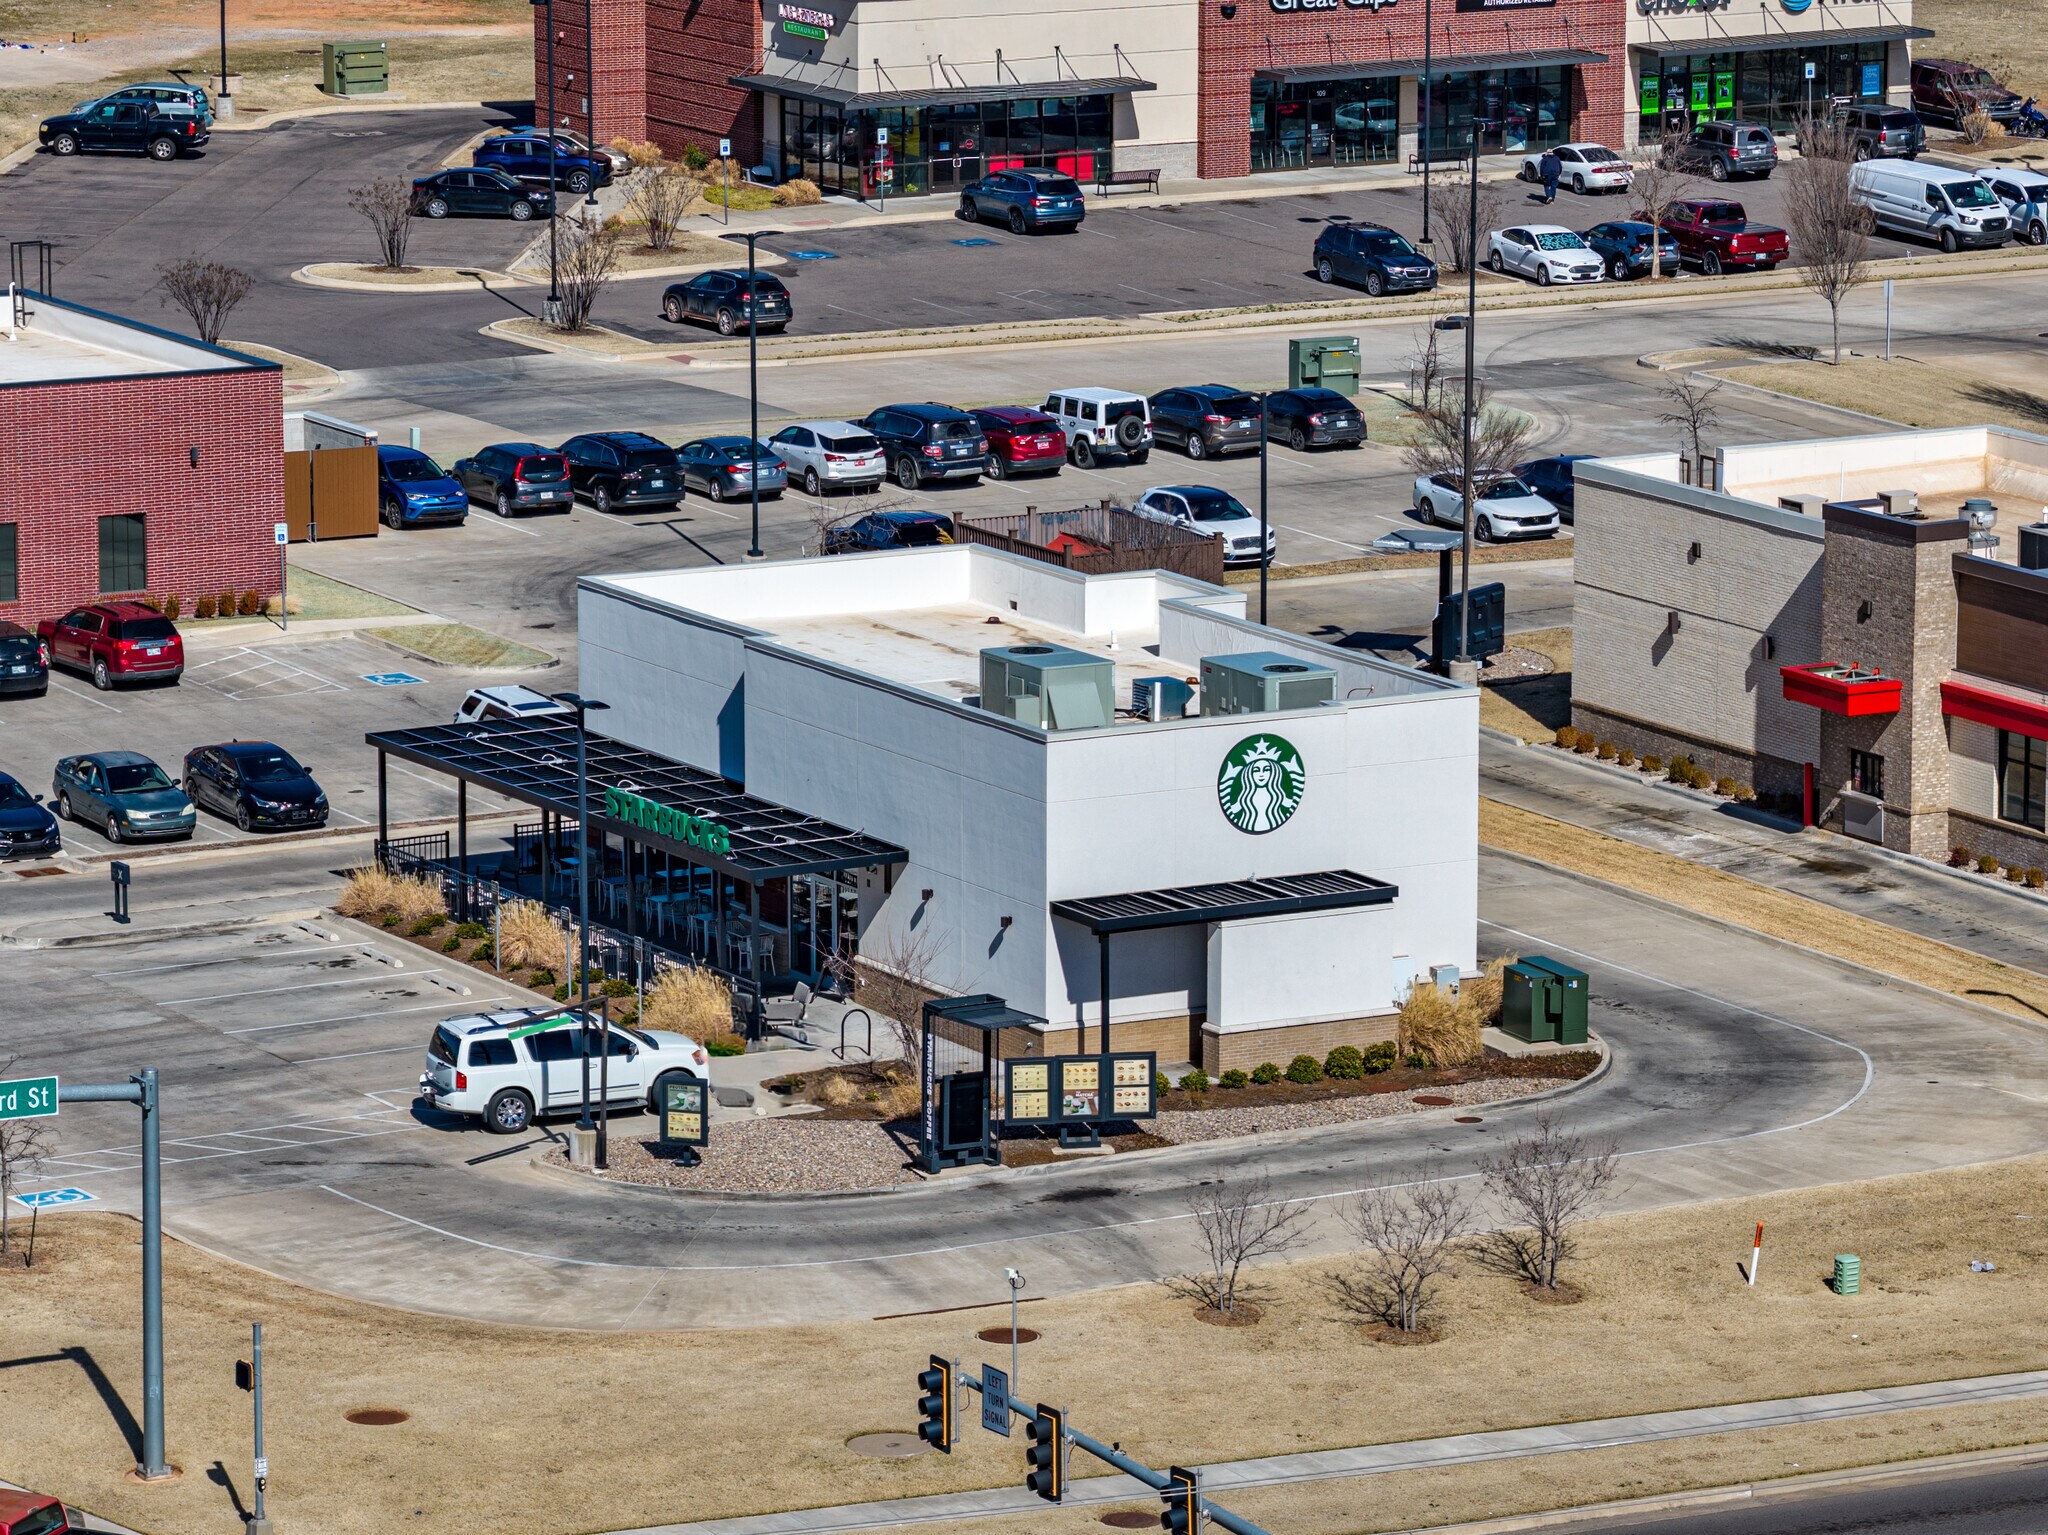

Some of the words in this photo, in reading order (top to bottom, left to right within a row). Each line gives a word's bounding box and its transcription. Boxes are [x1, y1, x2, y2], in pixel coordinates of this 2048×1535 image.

[787, 23, 822, 37] RESTAURANT
[1644, 89, 1657, 98] $25
[605, 787, 730, 855] STARBUCKS
[926, 1033, 934, 1096] STARBUCKS
[28, 1086, 49, 1108] St
[987, 1374, 1002, 1391] LEFT
[987, 1391, 1004, 1409] TURN
[984, 1408, 1007, 1429] SIGNAL
